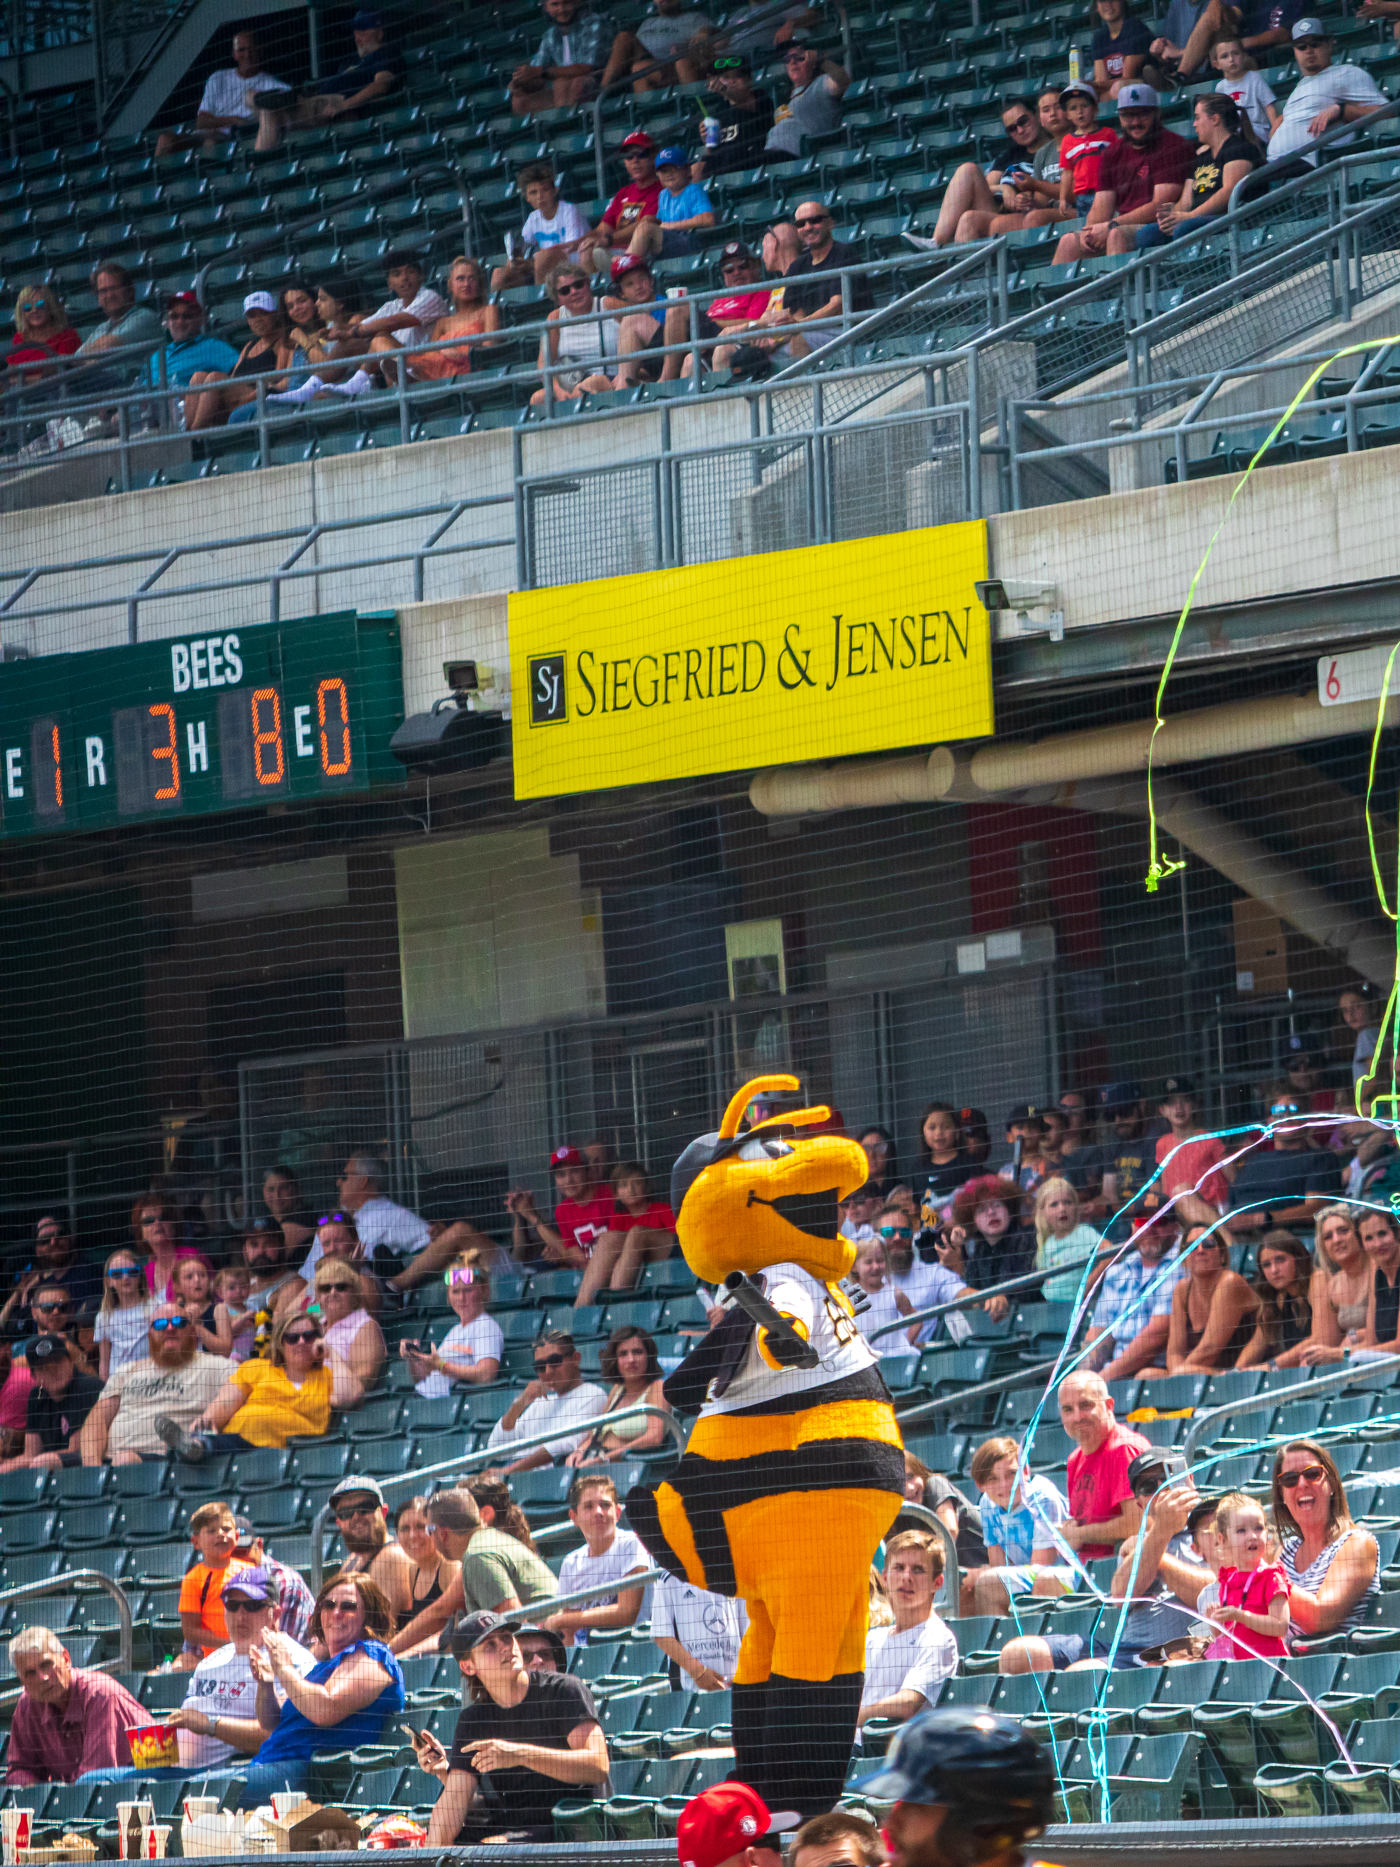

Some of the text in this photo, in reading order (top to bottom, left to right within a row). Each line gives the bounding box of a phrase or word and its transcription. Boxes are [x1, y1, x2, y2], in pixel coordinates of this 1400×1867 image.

[170, 633, 244, 693] BEES
[535, 664, 561, 716] SJ
[575, 606, 972, 717] SIEGFRIED & JENSEN
[1326, 661, 1340, 699] 6
[5, 677, 352, 807] E 1 R 3 H 8 E 0
